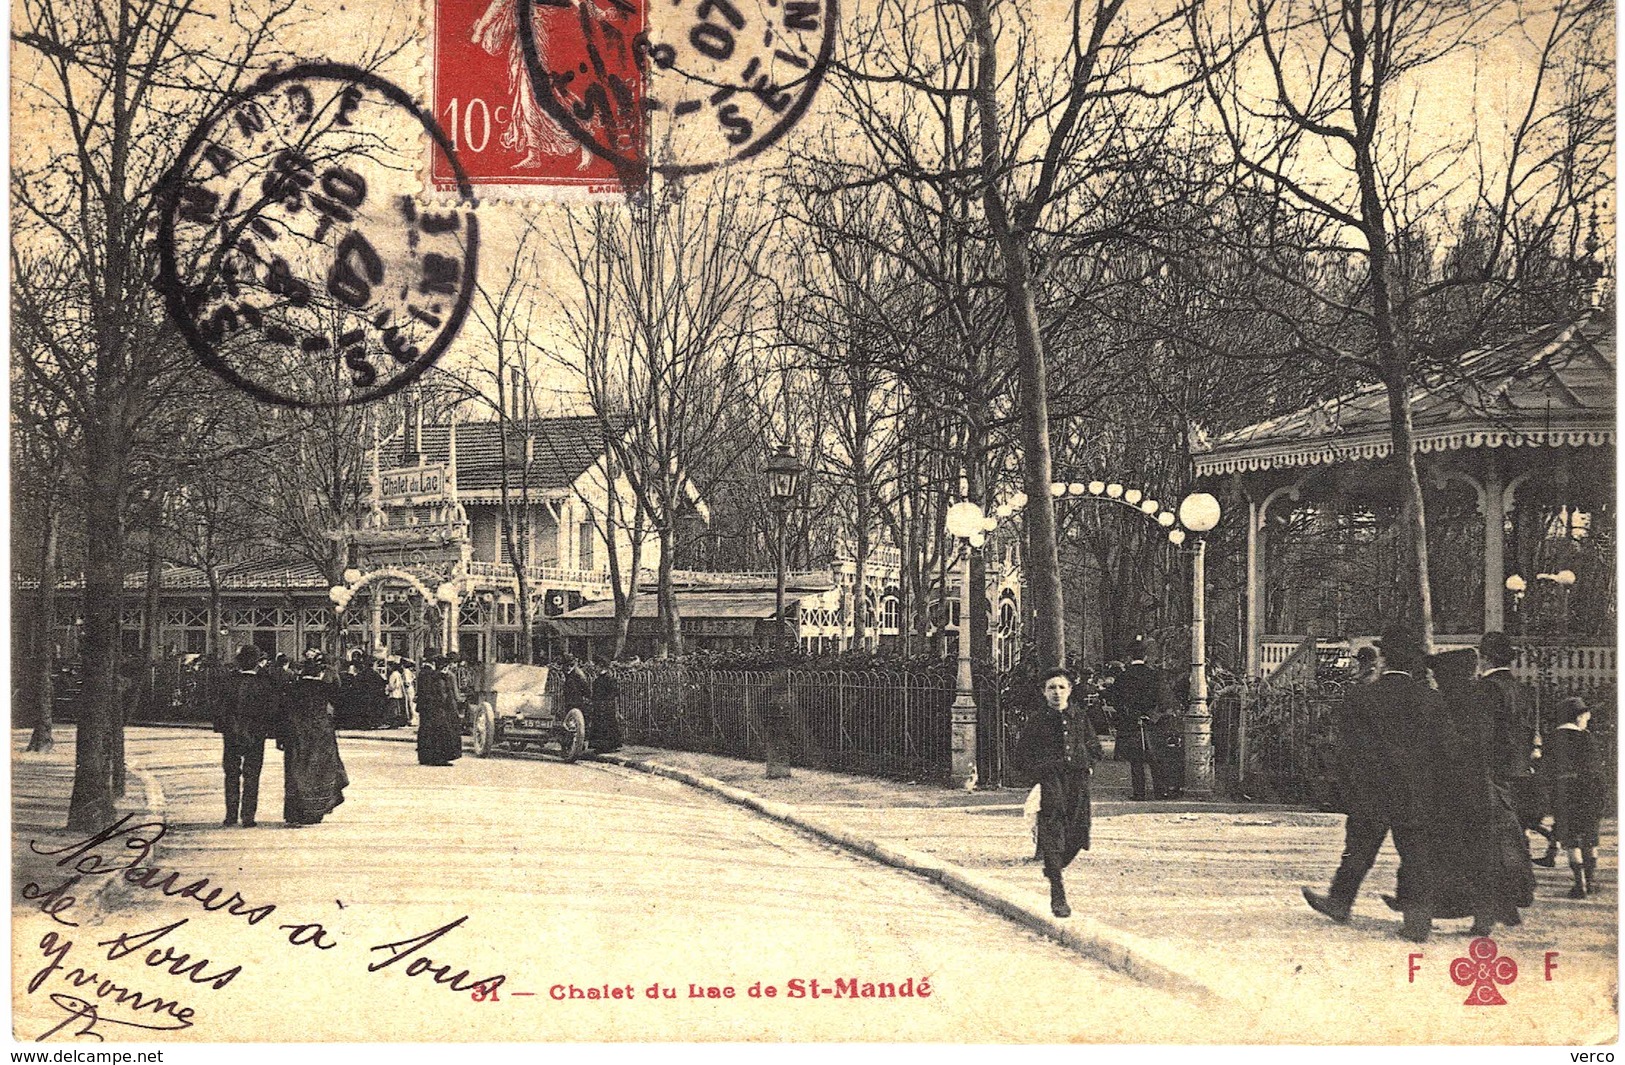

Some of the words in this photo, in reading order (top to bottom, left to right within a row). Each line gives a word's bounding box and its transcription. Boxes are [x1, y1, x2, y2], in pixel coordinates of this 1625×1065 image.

[689, 0, 746, 62] 07
[327, 230, 384, 306] 07
[382, 475, 408, 495] Chalet
[410, 478, 419, 492] du
[420, 471, 438, 492] Lac
[1408, 953, 1424, 984] F
[1544, 951, 1560, 982] F
[549, 983, 634, 1000] Chalet
[645, 983, 677, 1000] du
[689, 983, 736, 1000] Lac
[747, 981, 778, 999] de
[787, 976, 932, 1000] St-Mandé
